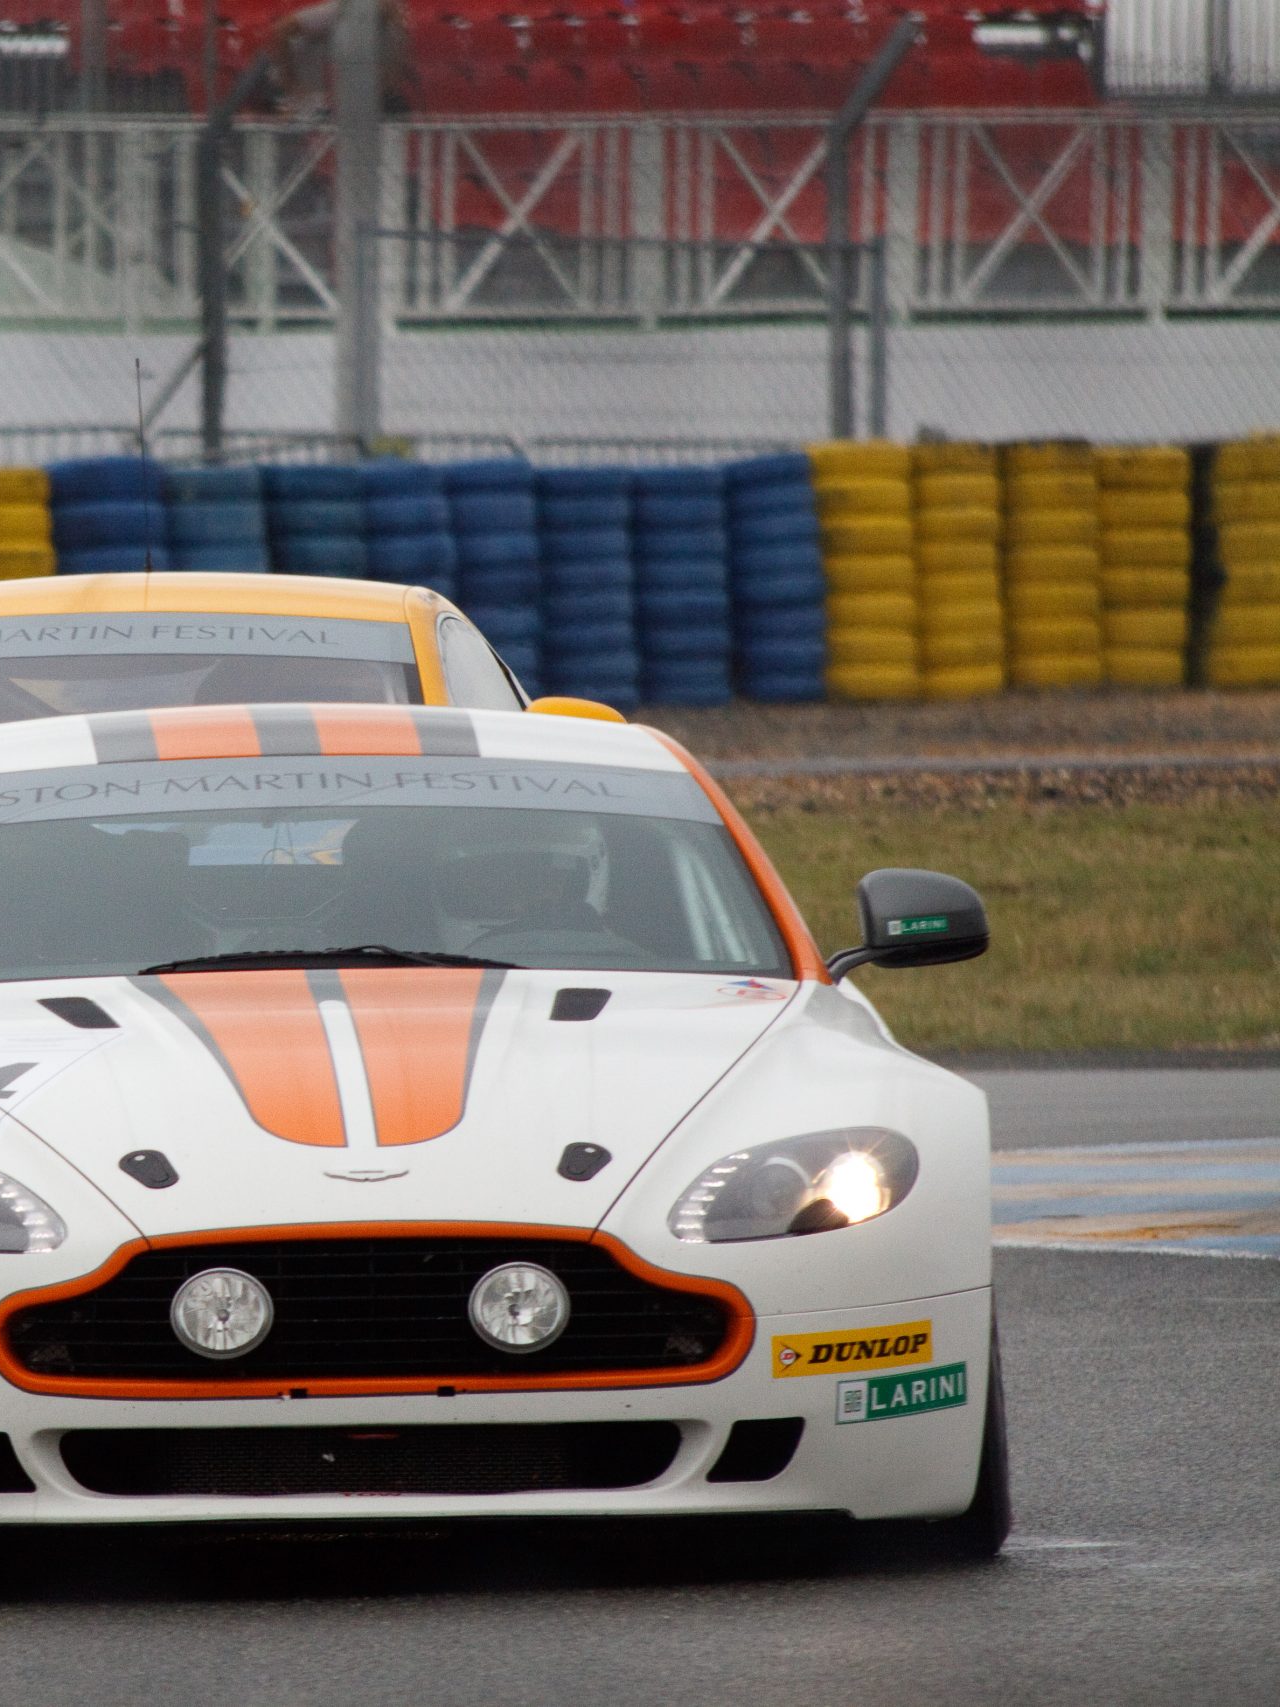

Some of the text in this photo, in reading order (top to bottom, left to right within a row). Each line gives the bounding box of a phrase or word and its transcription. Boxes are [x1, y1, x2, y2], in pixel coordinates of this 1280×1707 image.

[151, 625, 339, 645] FESTIVAL
[163, 773, 373, 794] MARTIN
[396, 772, 626, 798] FESTIVAL
[807, 1332, 928, 1365] DUNLOP
[870, 1371, 965, 1412] LARINI
